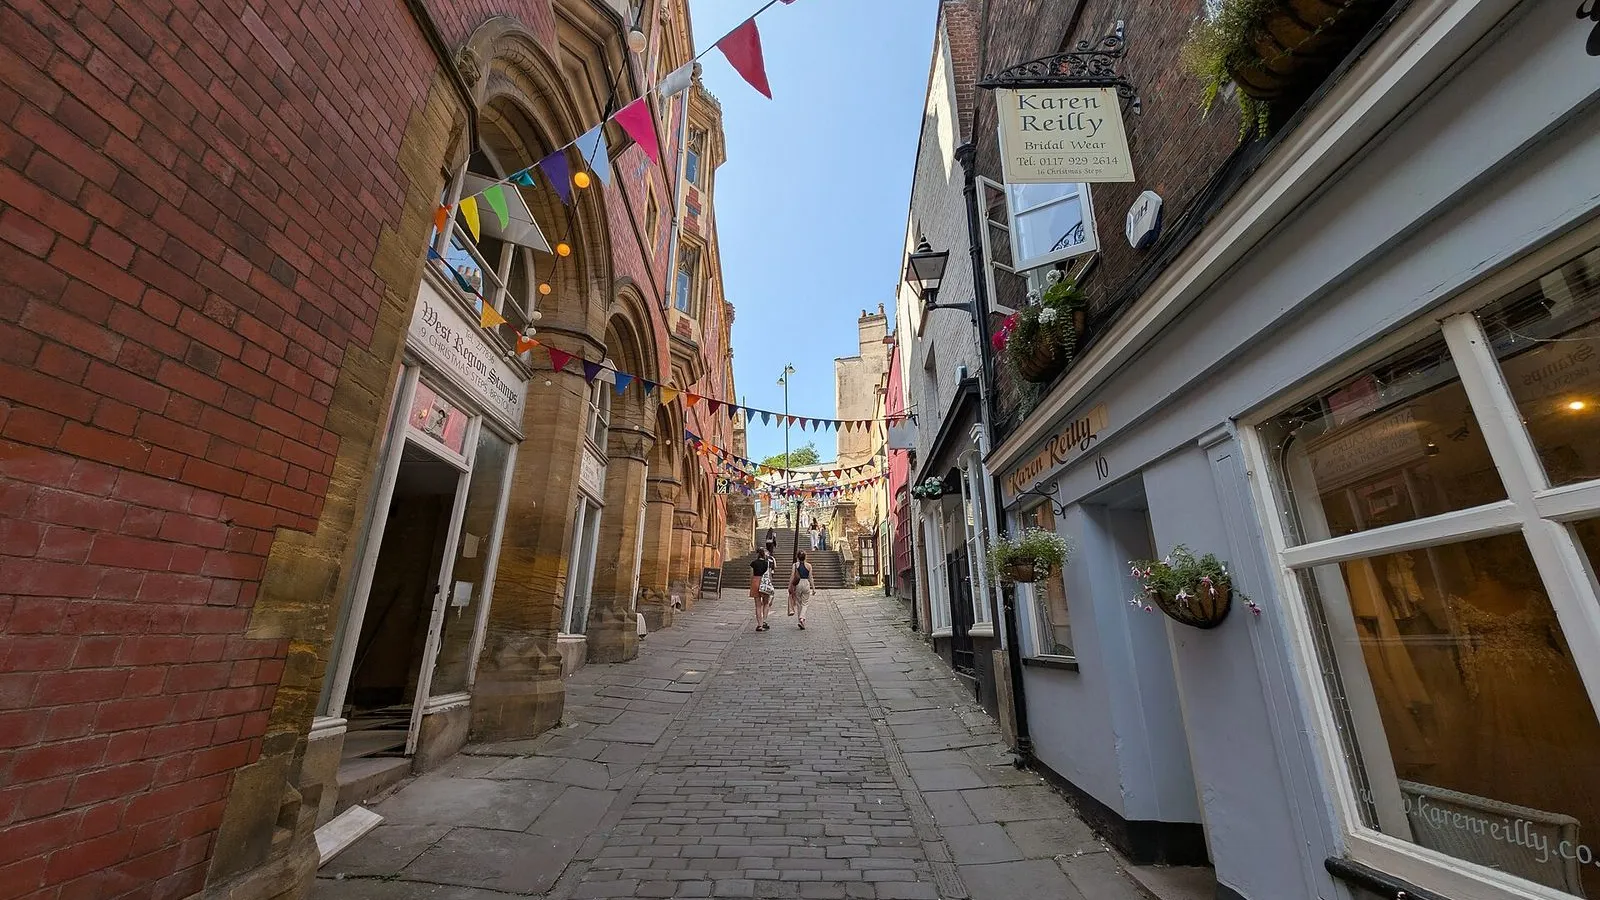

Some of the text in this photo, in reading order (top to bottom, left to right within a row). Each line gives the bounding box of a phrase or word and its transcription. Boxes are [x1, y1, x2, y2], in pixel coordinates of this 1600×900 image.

[1017, 94, 1100, 110] Karen
[1020, 112, 1103, 137] Reilly
[1025, 140, 1106, 150] Bridal Wear
[1016, 156, 1118, 166] Tel: 0117 929 2614
[1083, 168, 1103, 176] Steps
[420, 327, 427, 338] 9
[429, 335, 470, 376] CHRISTMAS
[421, 300, 518, 405] West Region Stamps
[1008, 417, 1098, 495] Karen Reilly
